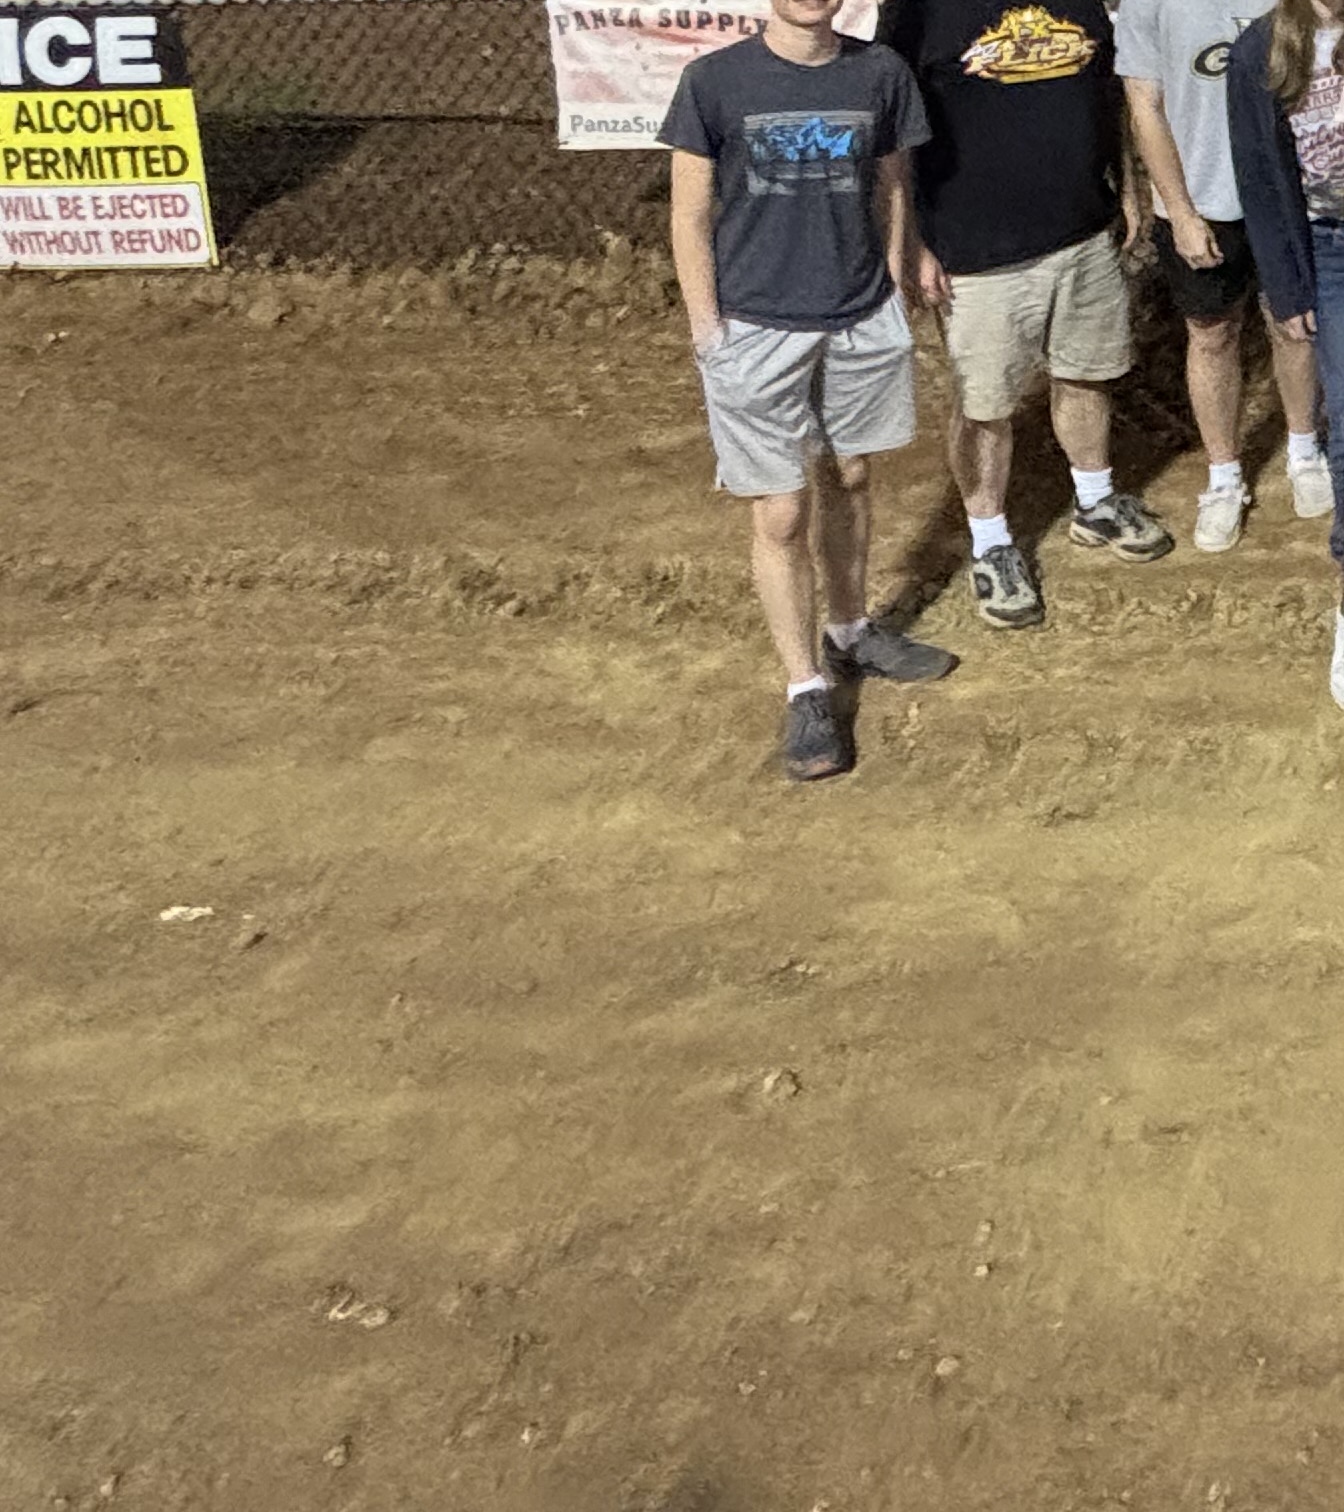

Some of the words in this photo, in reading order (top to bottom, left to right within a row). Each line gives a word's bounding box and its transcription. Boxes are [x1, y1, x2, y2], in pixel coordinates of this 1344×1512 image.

[553, 7, 643, 36] PANZA
[14, 99, 175, 134] ALCOHOL
[569, 114, 665, 134] PanzaSu
[2, 143, 190, 180] PERMITTED
[0, 195, 53, 222] WILL
[56, 195, 86, 220] BE
[92, 193, 190, 219] EJECTED
[2, 230, 103, 255] WITHOUT
[111, 228, 201, 254] REFUND
